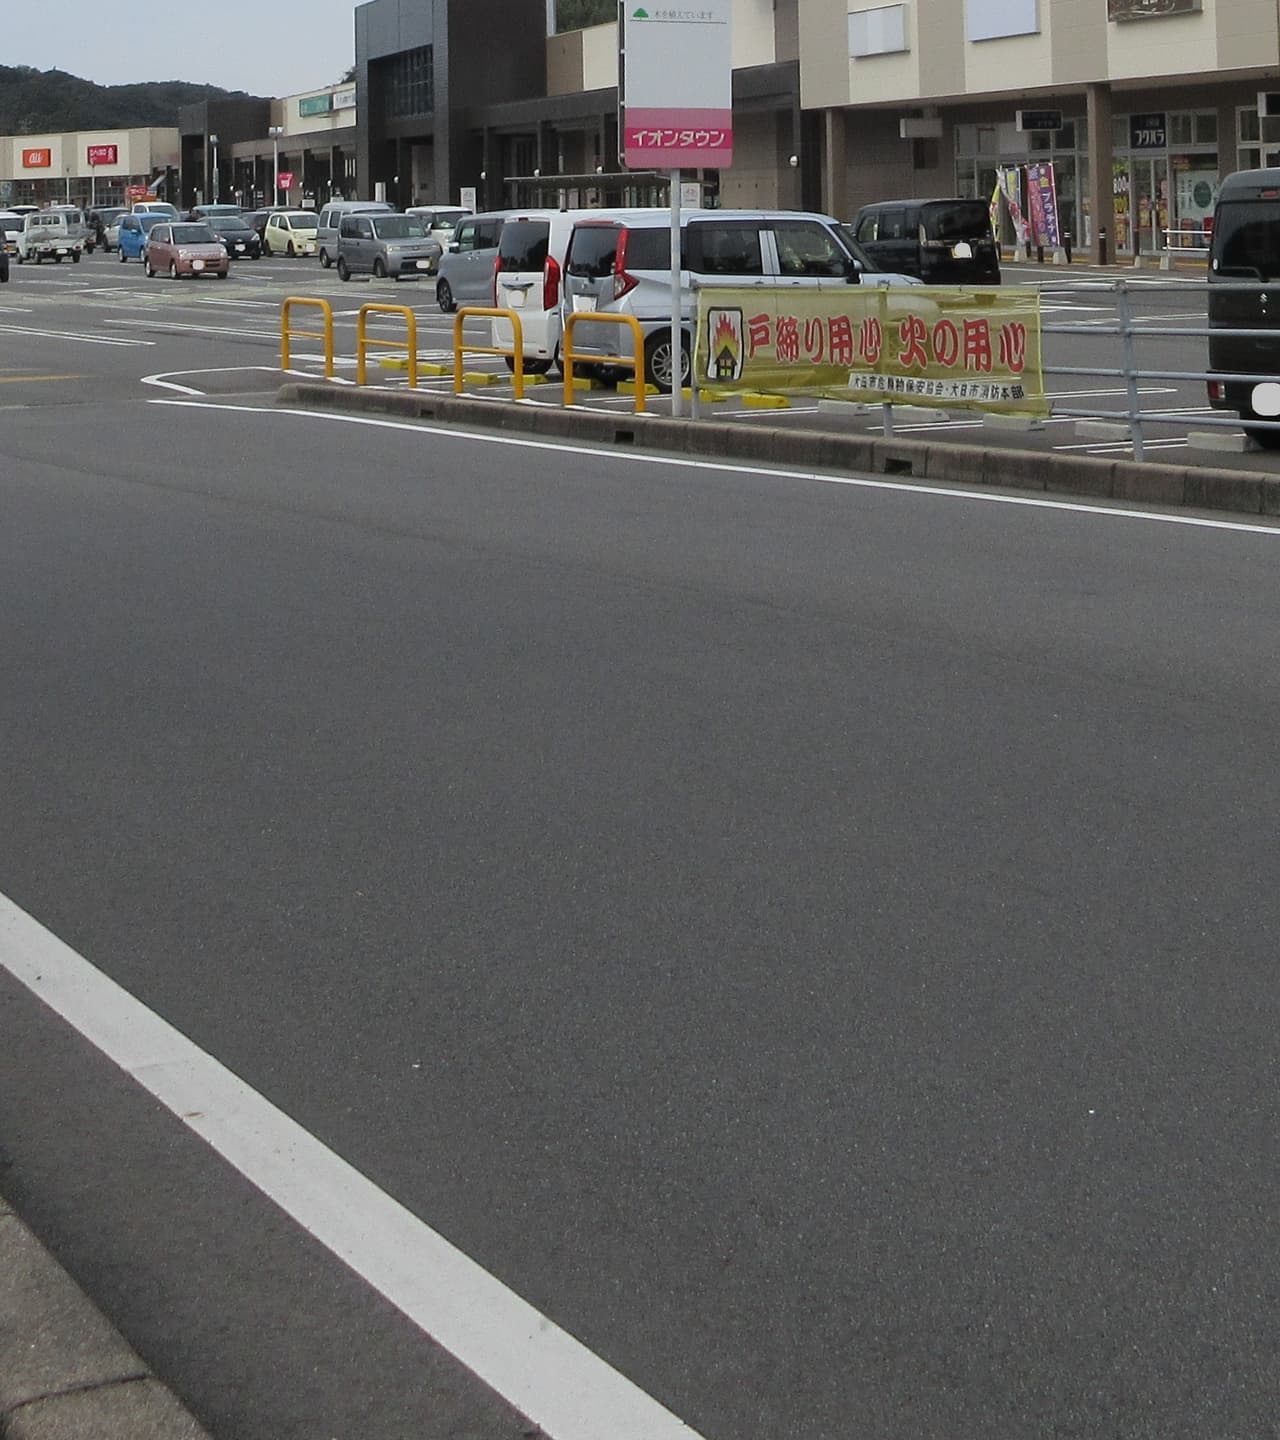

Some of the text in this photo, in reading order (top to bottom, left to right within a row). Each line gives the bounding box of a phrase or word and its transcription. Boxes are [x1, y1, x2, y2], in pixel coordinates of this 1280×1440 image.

[632, 129, 725, 148] イオンタウン
[747, 313, 1027, 374] 戸締り用心 火の用心
